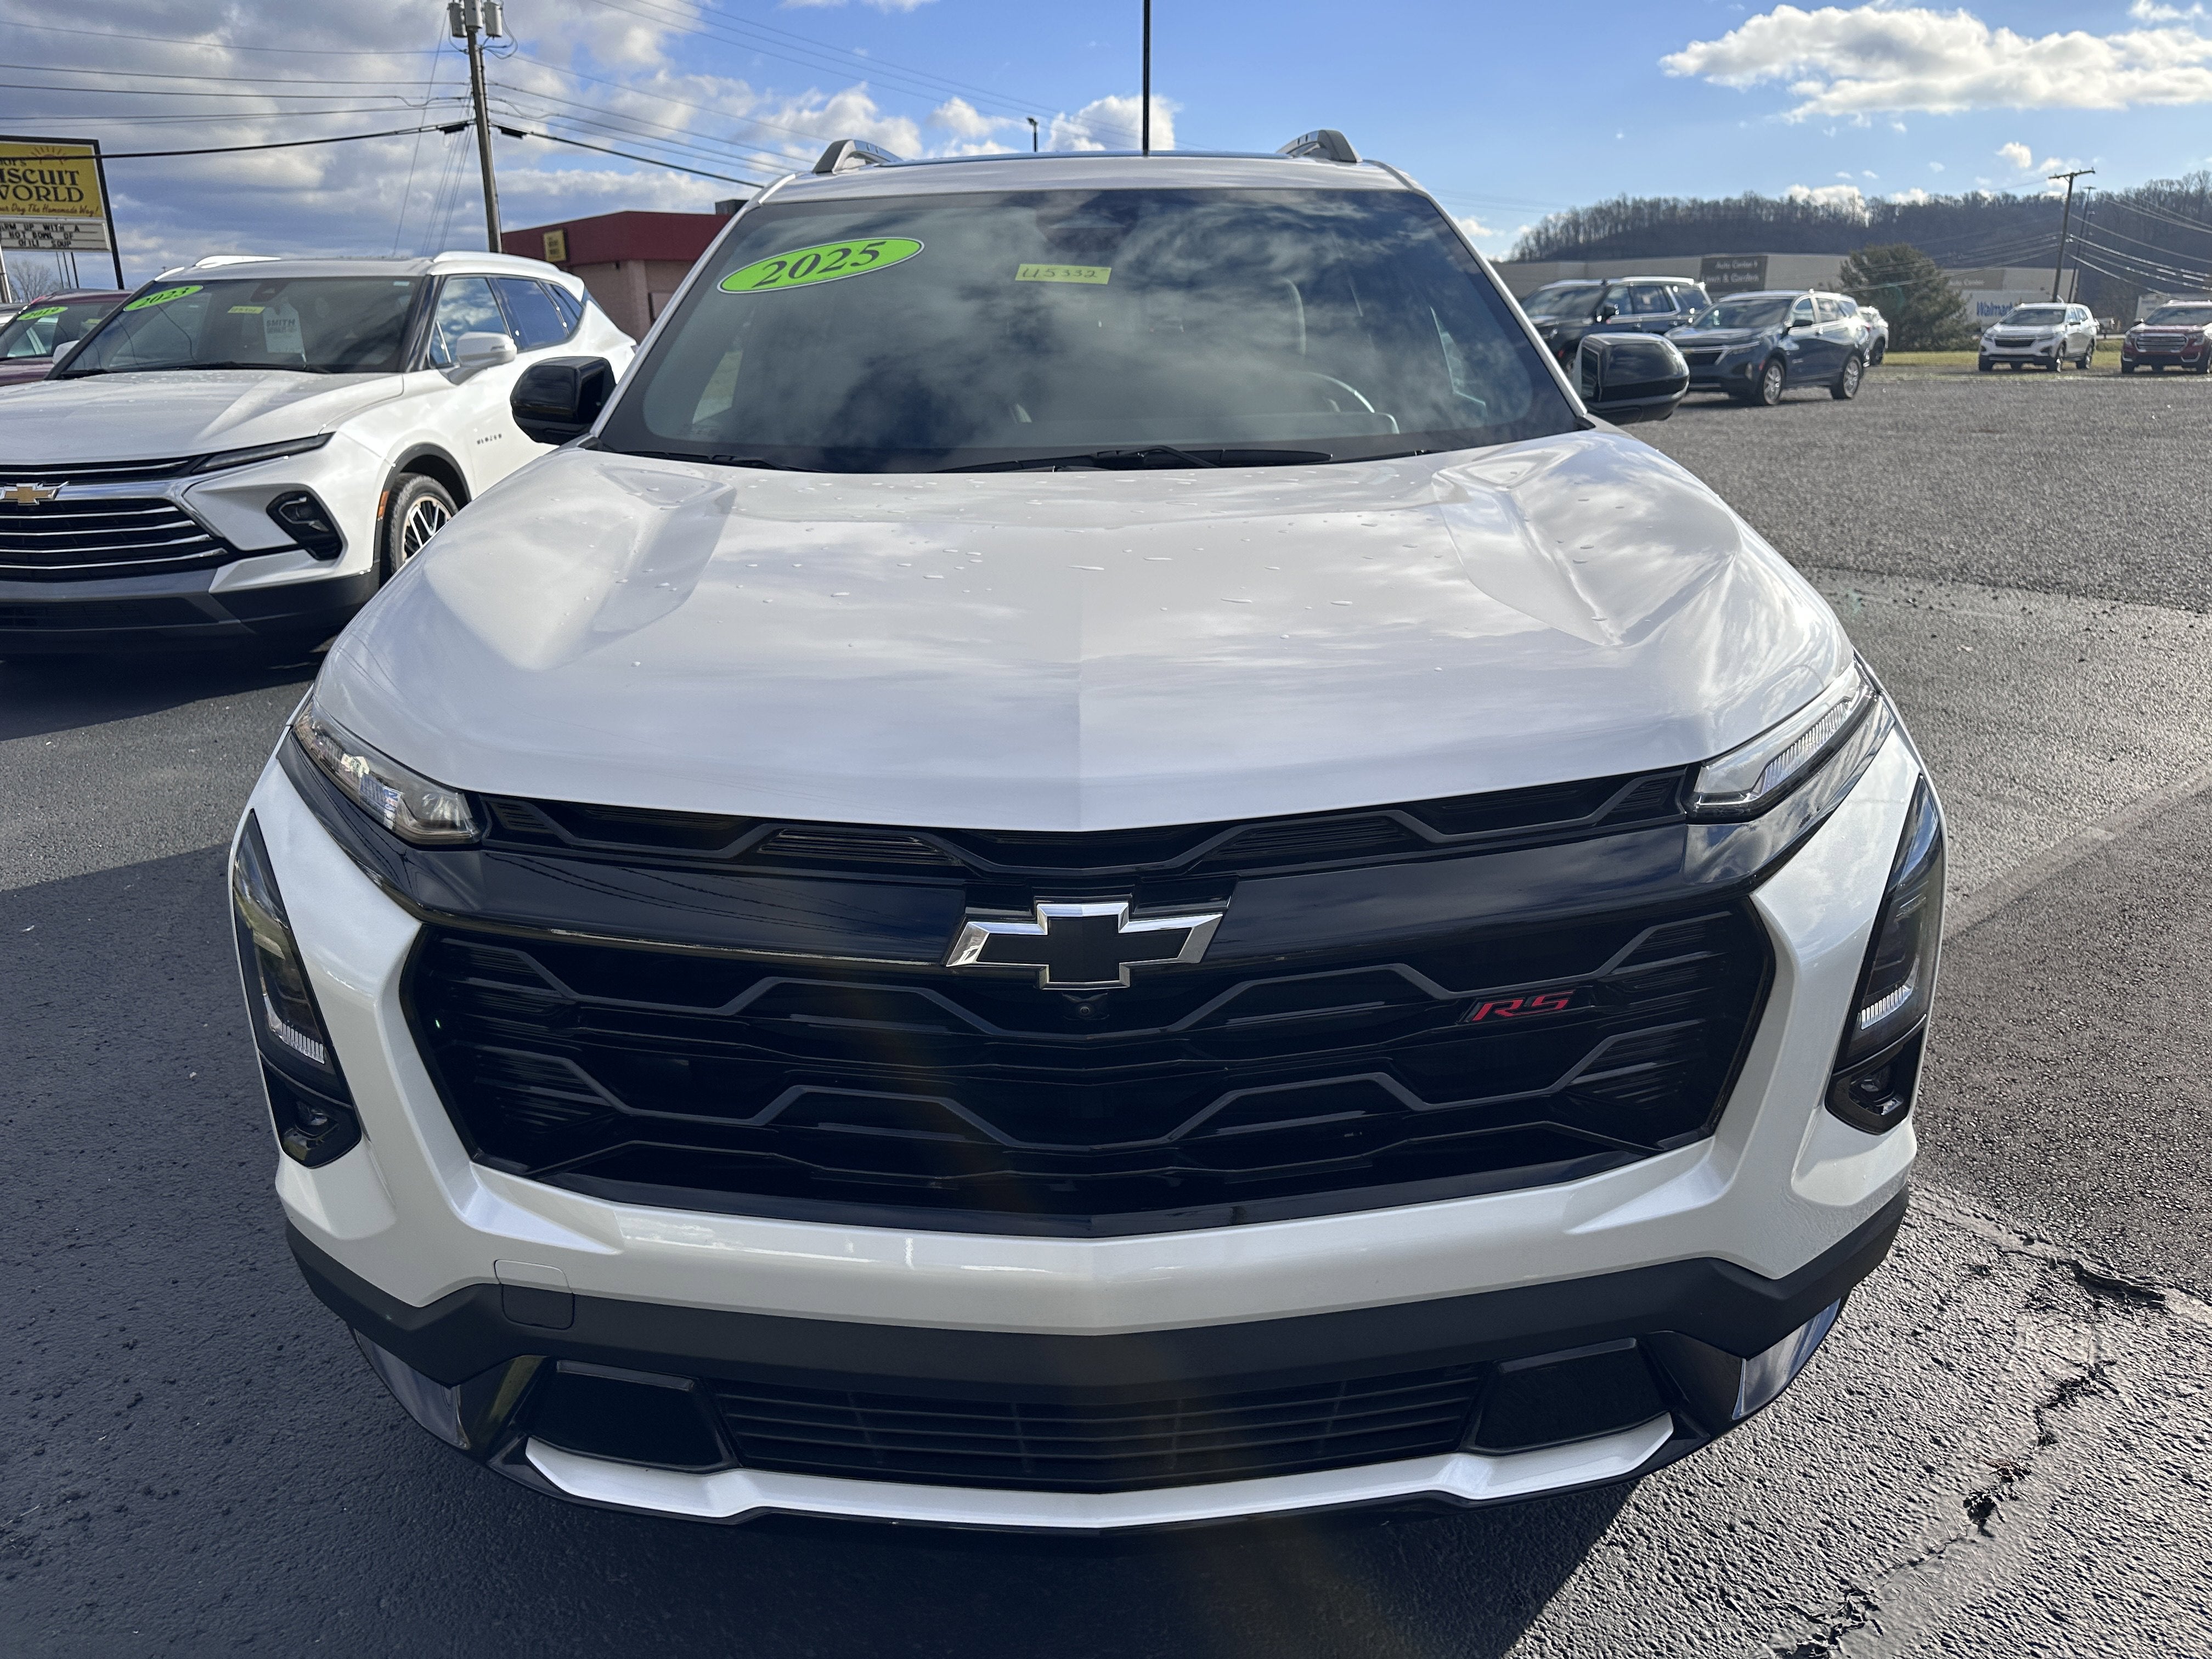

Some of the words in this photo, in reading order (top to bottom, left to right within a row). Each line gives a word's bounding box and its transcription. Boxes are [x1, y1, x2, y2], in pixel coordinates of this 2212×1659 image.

[0, 168, 80, 186] ISCUIT
[28, 204, 40, 213] The
[751, 241, 887, 289] 2025
[136, 287, 190, 308] 2023
[1471, 990, 1575, 1022] RS
